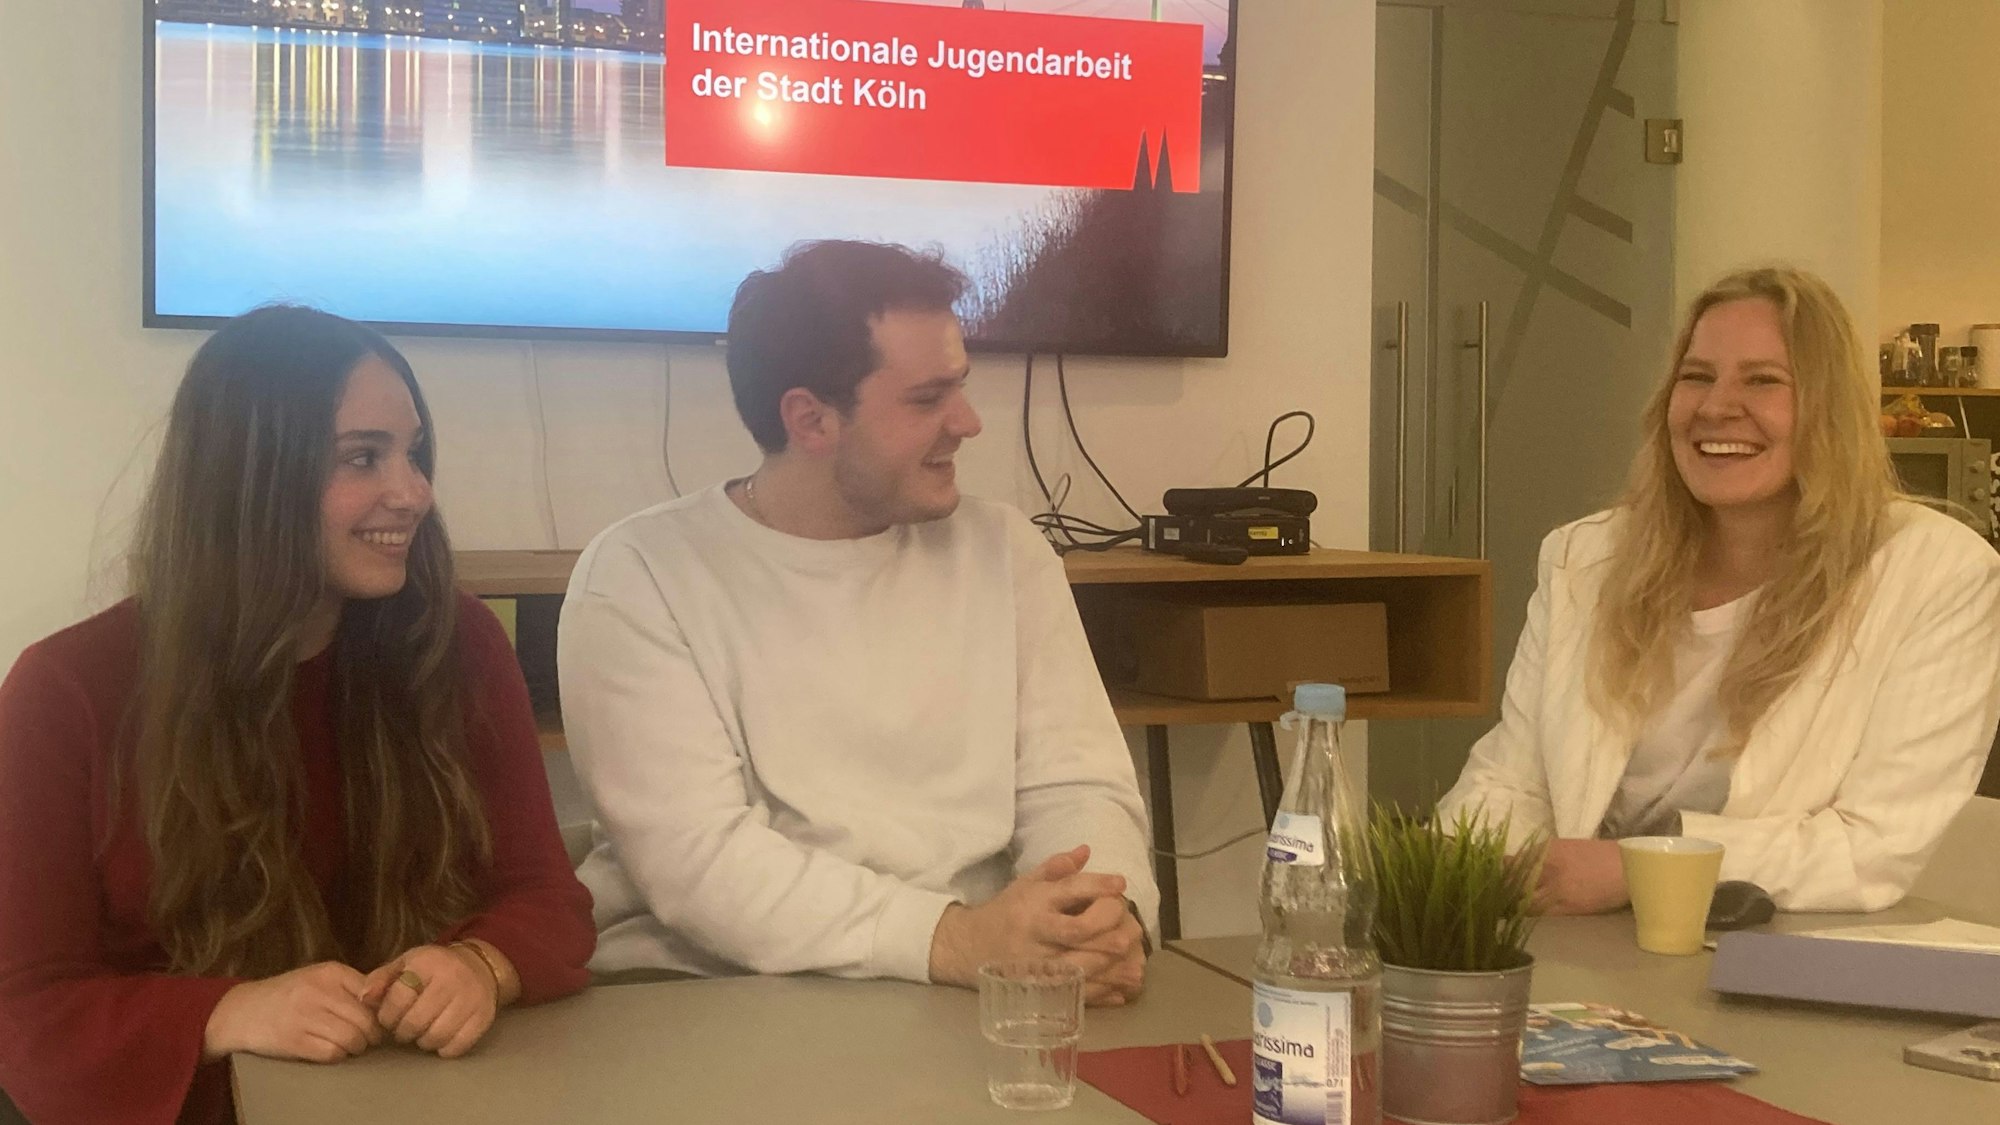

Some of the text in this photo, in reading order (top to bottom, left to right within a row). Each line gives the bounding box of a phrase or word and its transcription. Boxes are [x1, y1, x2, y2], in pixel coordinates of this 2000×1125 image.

[691, 22, 1132, 81] Internationale Jugendarbeit
[691, 69, 927, 111] der Stadt Köln
